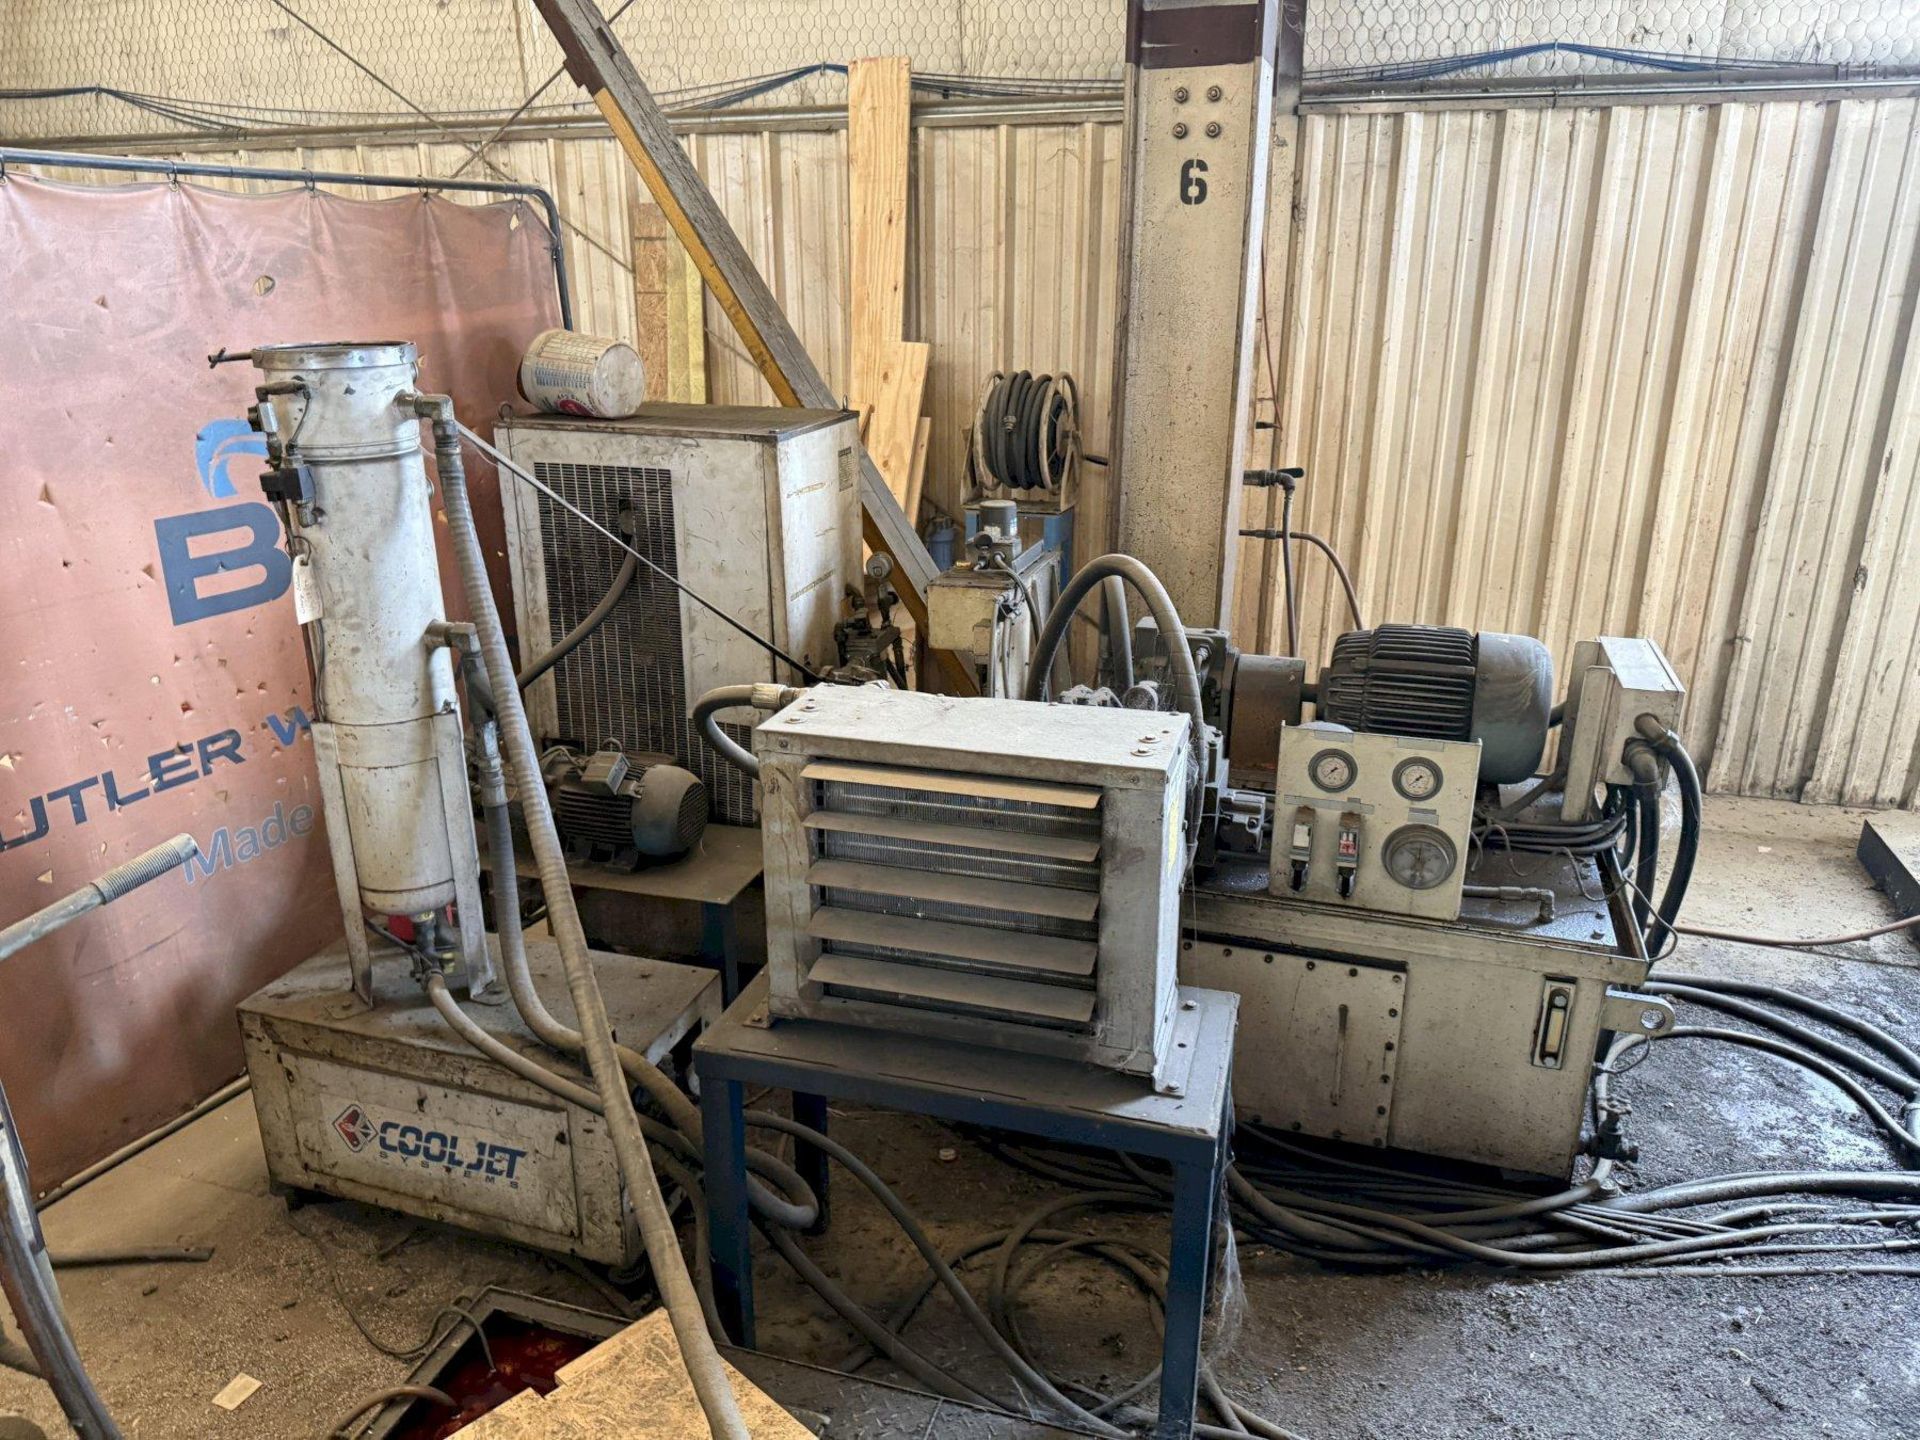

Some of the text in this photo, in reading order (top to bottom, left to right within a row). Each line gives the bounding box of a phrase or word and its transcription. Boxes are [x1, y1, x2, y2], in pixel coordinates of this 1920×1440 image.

[1180, 159, 1209, 205] 6
[154, 502, 292, 626] B
[183, 800, 315, 887] Made
[379, 1121, 527, 1179] COOLJET
